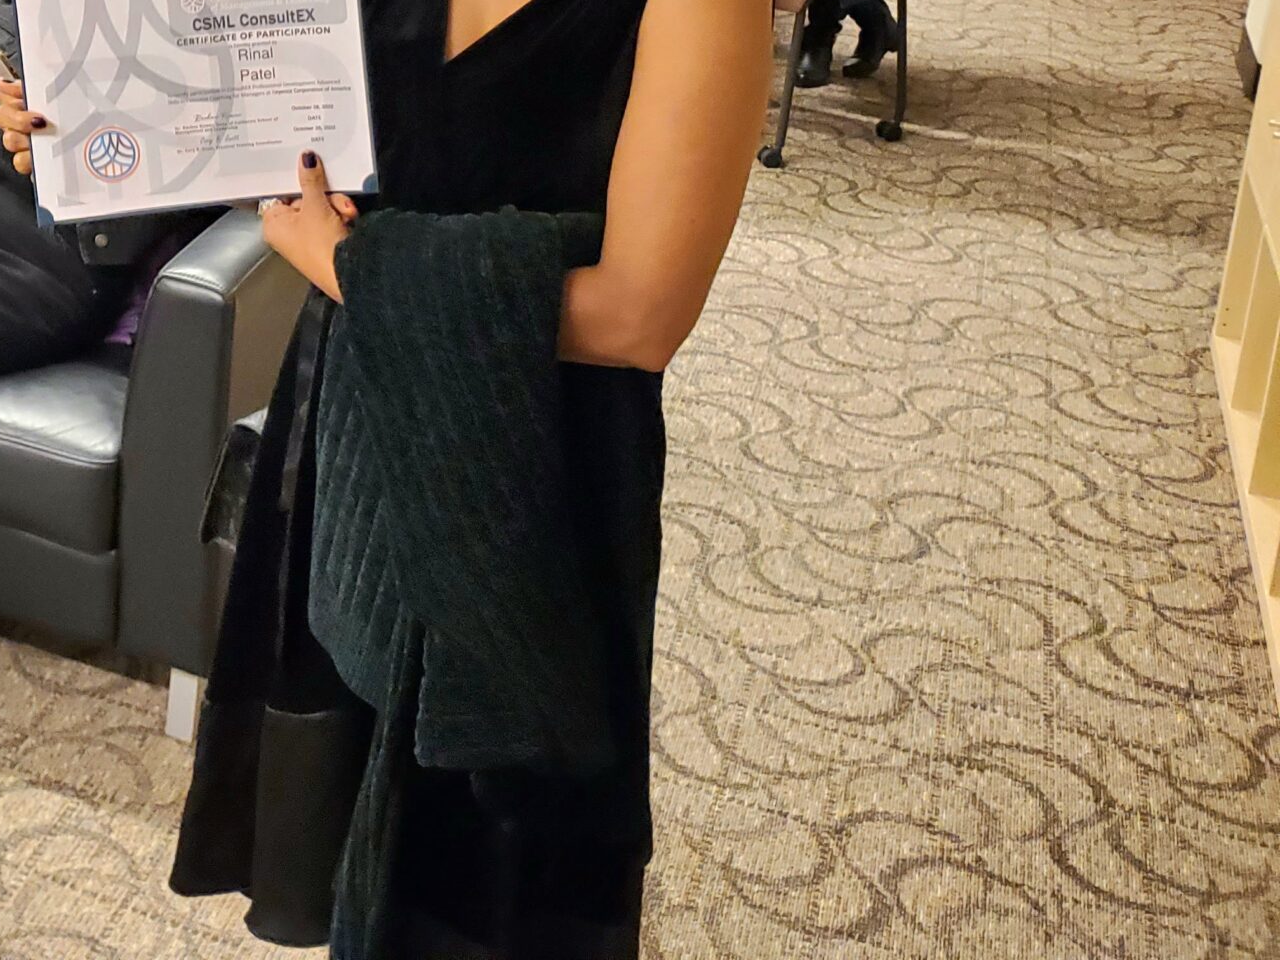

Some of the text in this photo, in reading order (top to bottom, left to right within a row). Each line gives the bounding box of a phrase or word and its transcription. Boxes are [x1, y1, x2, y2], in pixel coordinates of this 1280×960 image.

[192, 8, 316, 31] CSML ConsultEX
[176, 25, 331, 47] CERTIFICATE OF PARTICIPATION
[238, 46, 273, 61] Rinal
[240, 67, 275, 82] Patel
